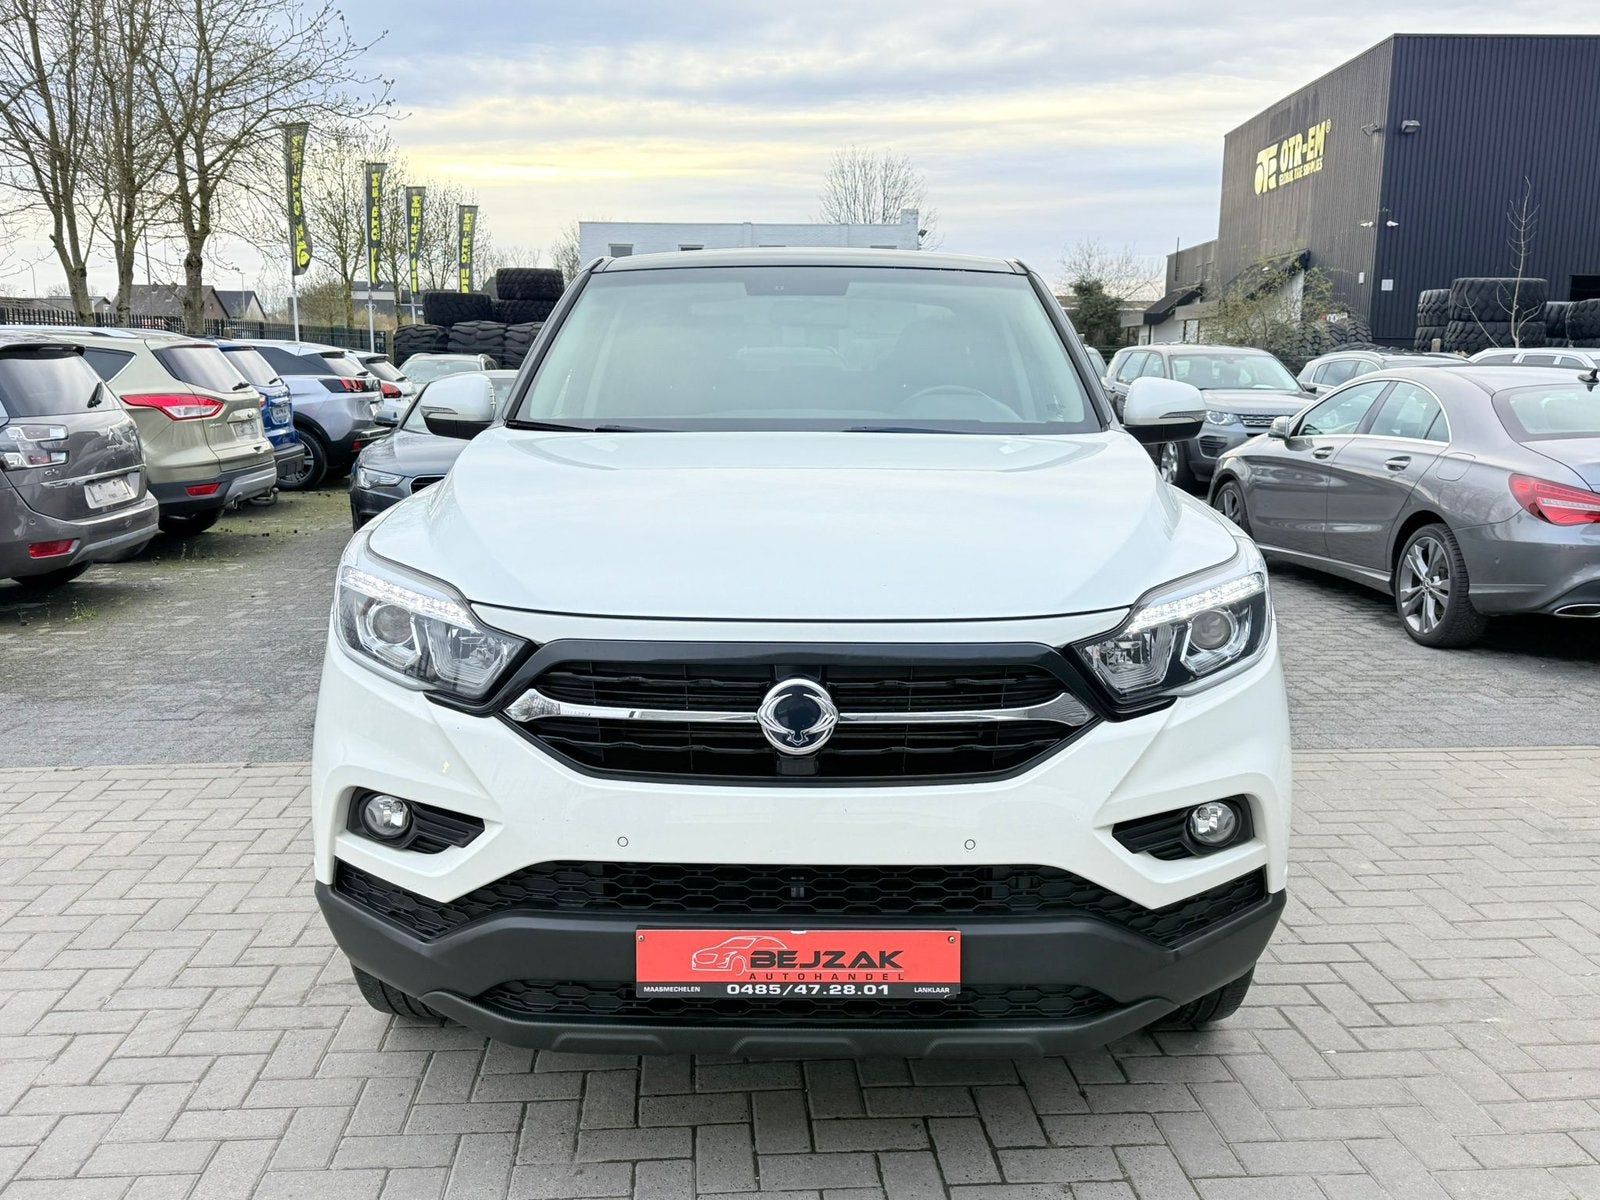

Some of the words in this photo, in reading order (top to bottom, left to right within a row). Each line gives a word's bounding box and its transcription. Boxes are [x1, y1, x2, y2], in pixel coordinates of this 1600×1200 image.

[750, 950, 904, 969] BEJZAK
[748, 972, 904, 981] AUTOHANDEL
[726, 984, 889, 996] 0485/47.28.01
